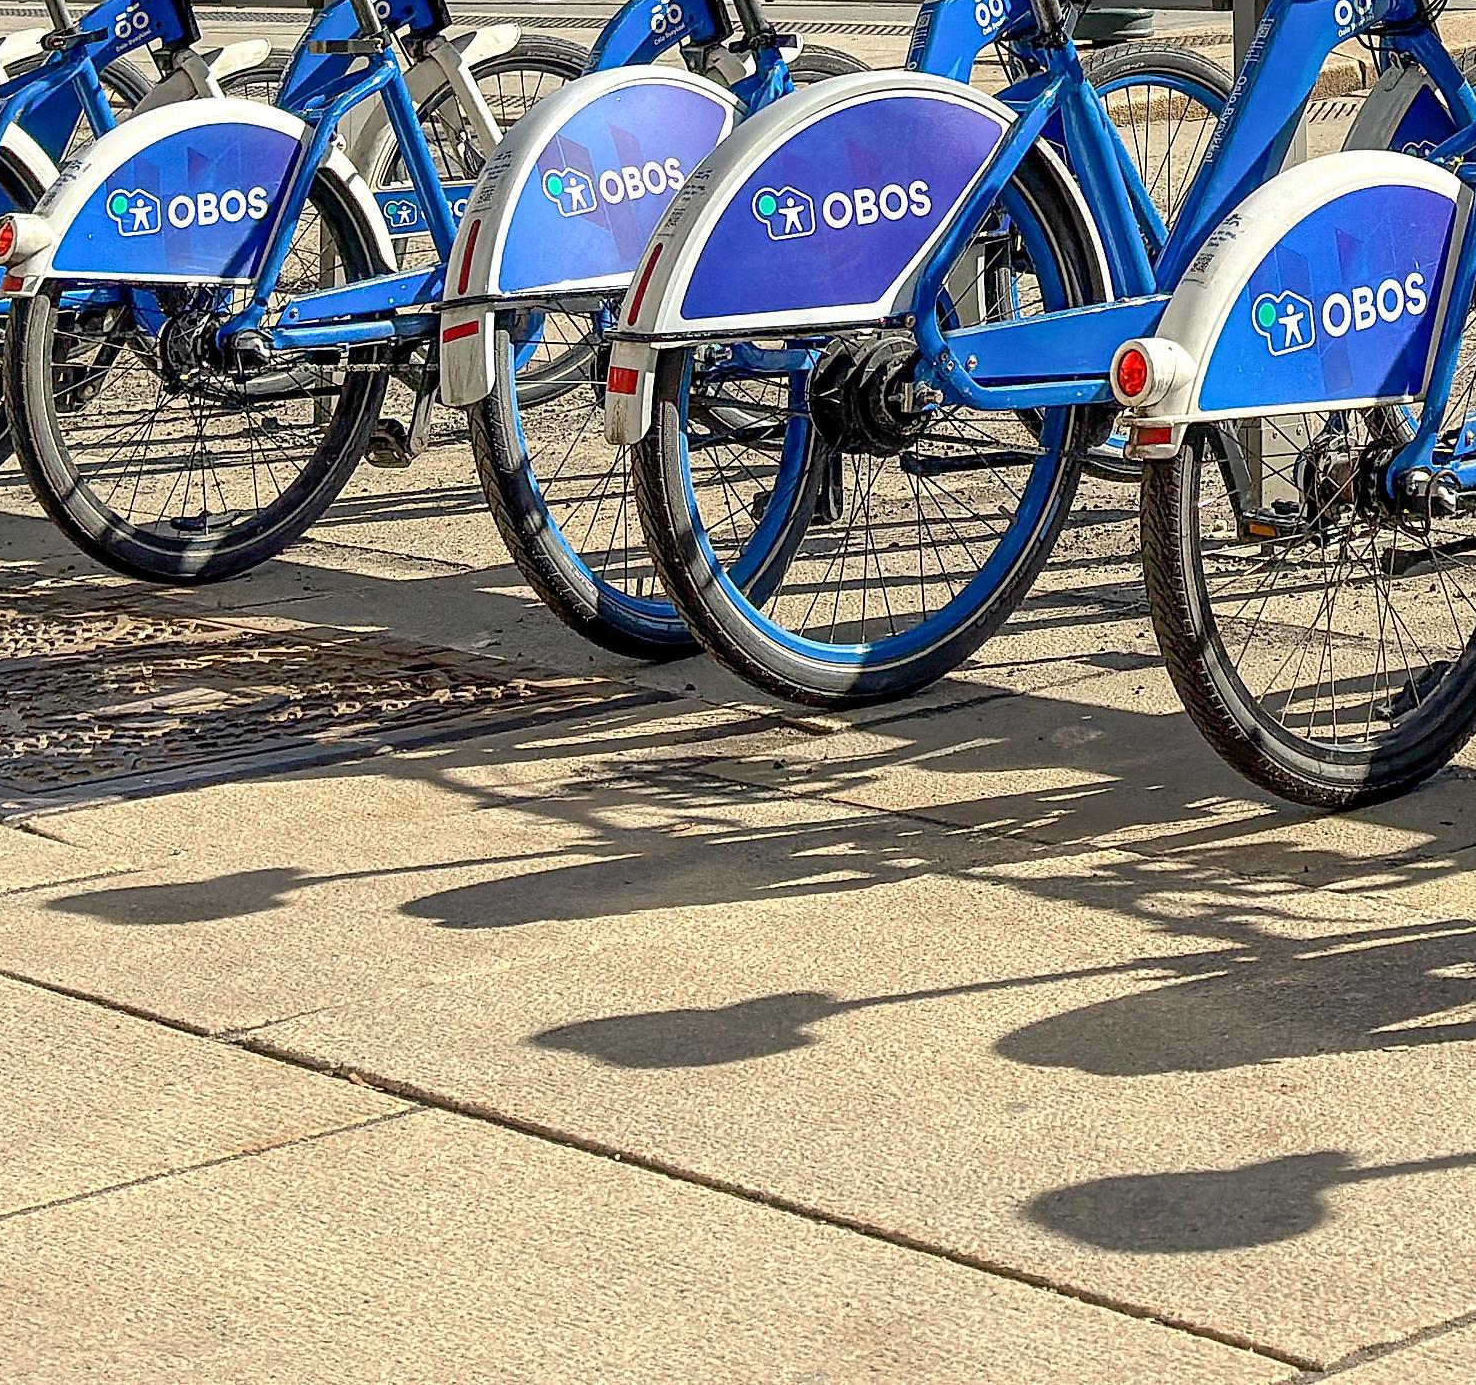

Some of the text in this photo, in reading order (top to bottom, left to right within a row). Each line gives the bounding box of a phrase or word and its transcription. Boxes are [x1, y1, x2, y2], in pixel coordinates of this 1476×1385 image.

[599, 156, 685, 204] OBOS
[822, 179, 934, 230] OBOS
[167, 186, 269, 229] OBOS
[1322, 272, 1428, 338] OBOS
